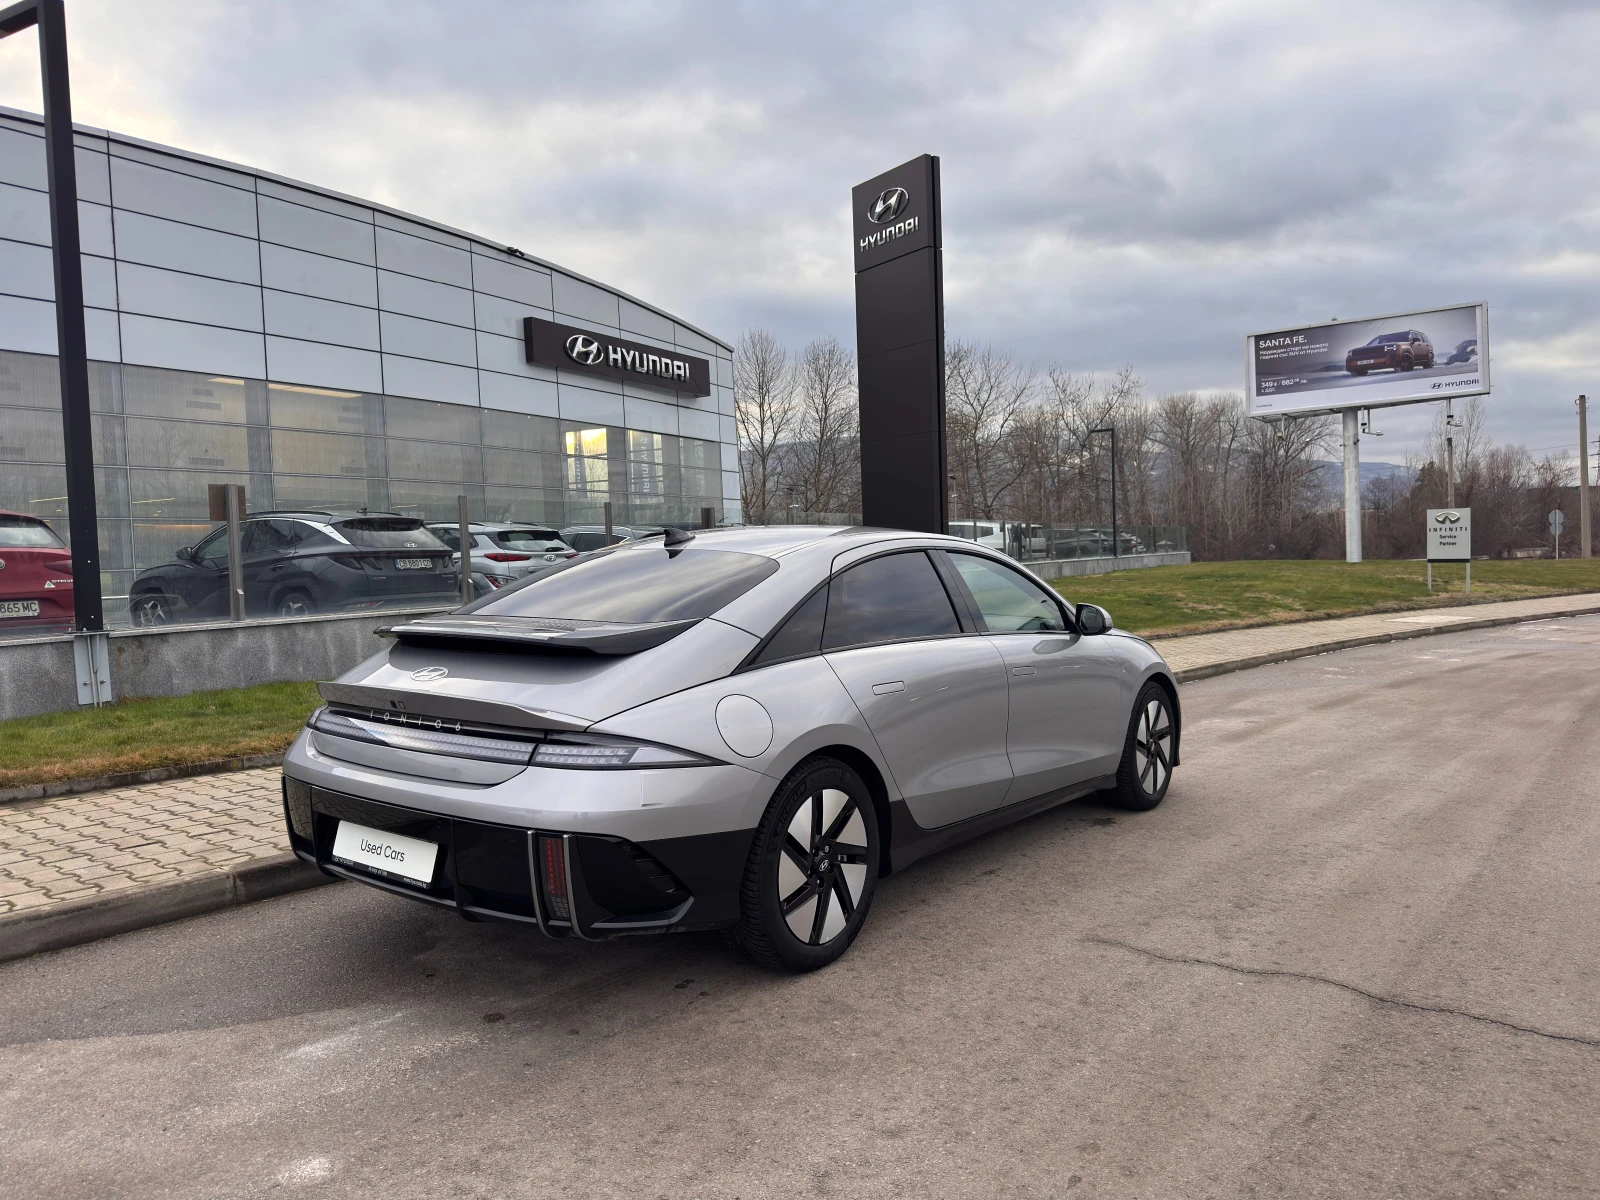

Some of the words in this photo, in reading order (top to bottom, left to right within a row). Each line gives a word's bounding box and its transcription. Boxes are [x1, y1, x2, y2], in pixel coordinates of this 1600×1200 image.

[860, 216, 919, 252] HYUNDAI
[1259, 338, 1292, 348] SANTA
[1293, 336, 1307, 344] FE.
[607, 345, 690, 381] HYUNDAI
[1444, 378, 1480, 388] HYUNDAI
[22, 602, 38, 612] MC
[369, 709, 442, 729] IONIQ
[455, 721, 461, 731] 6
[360, 838, 383, 856] Used
[384, 845, 405, 862] Cars
